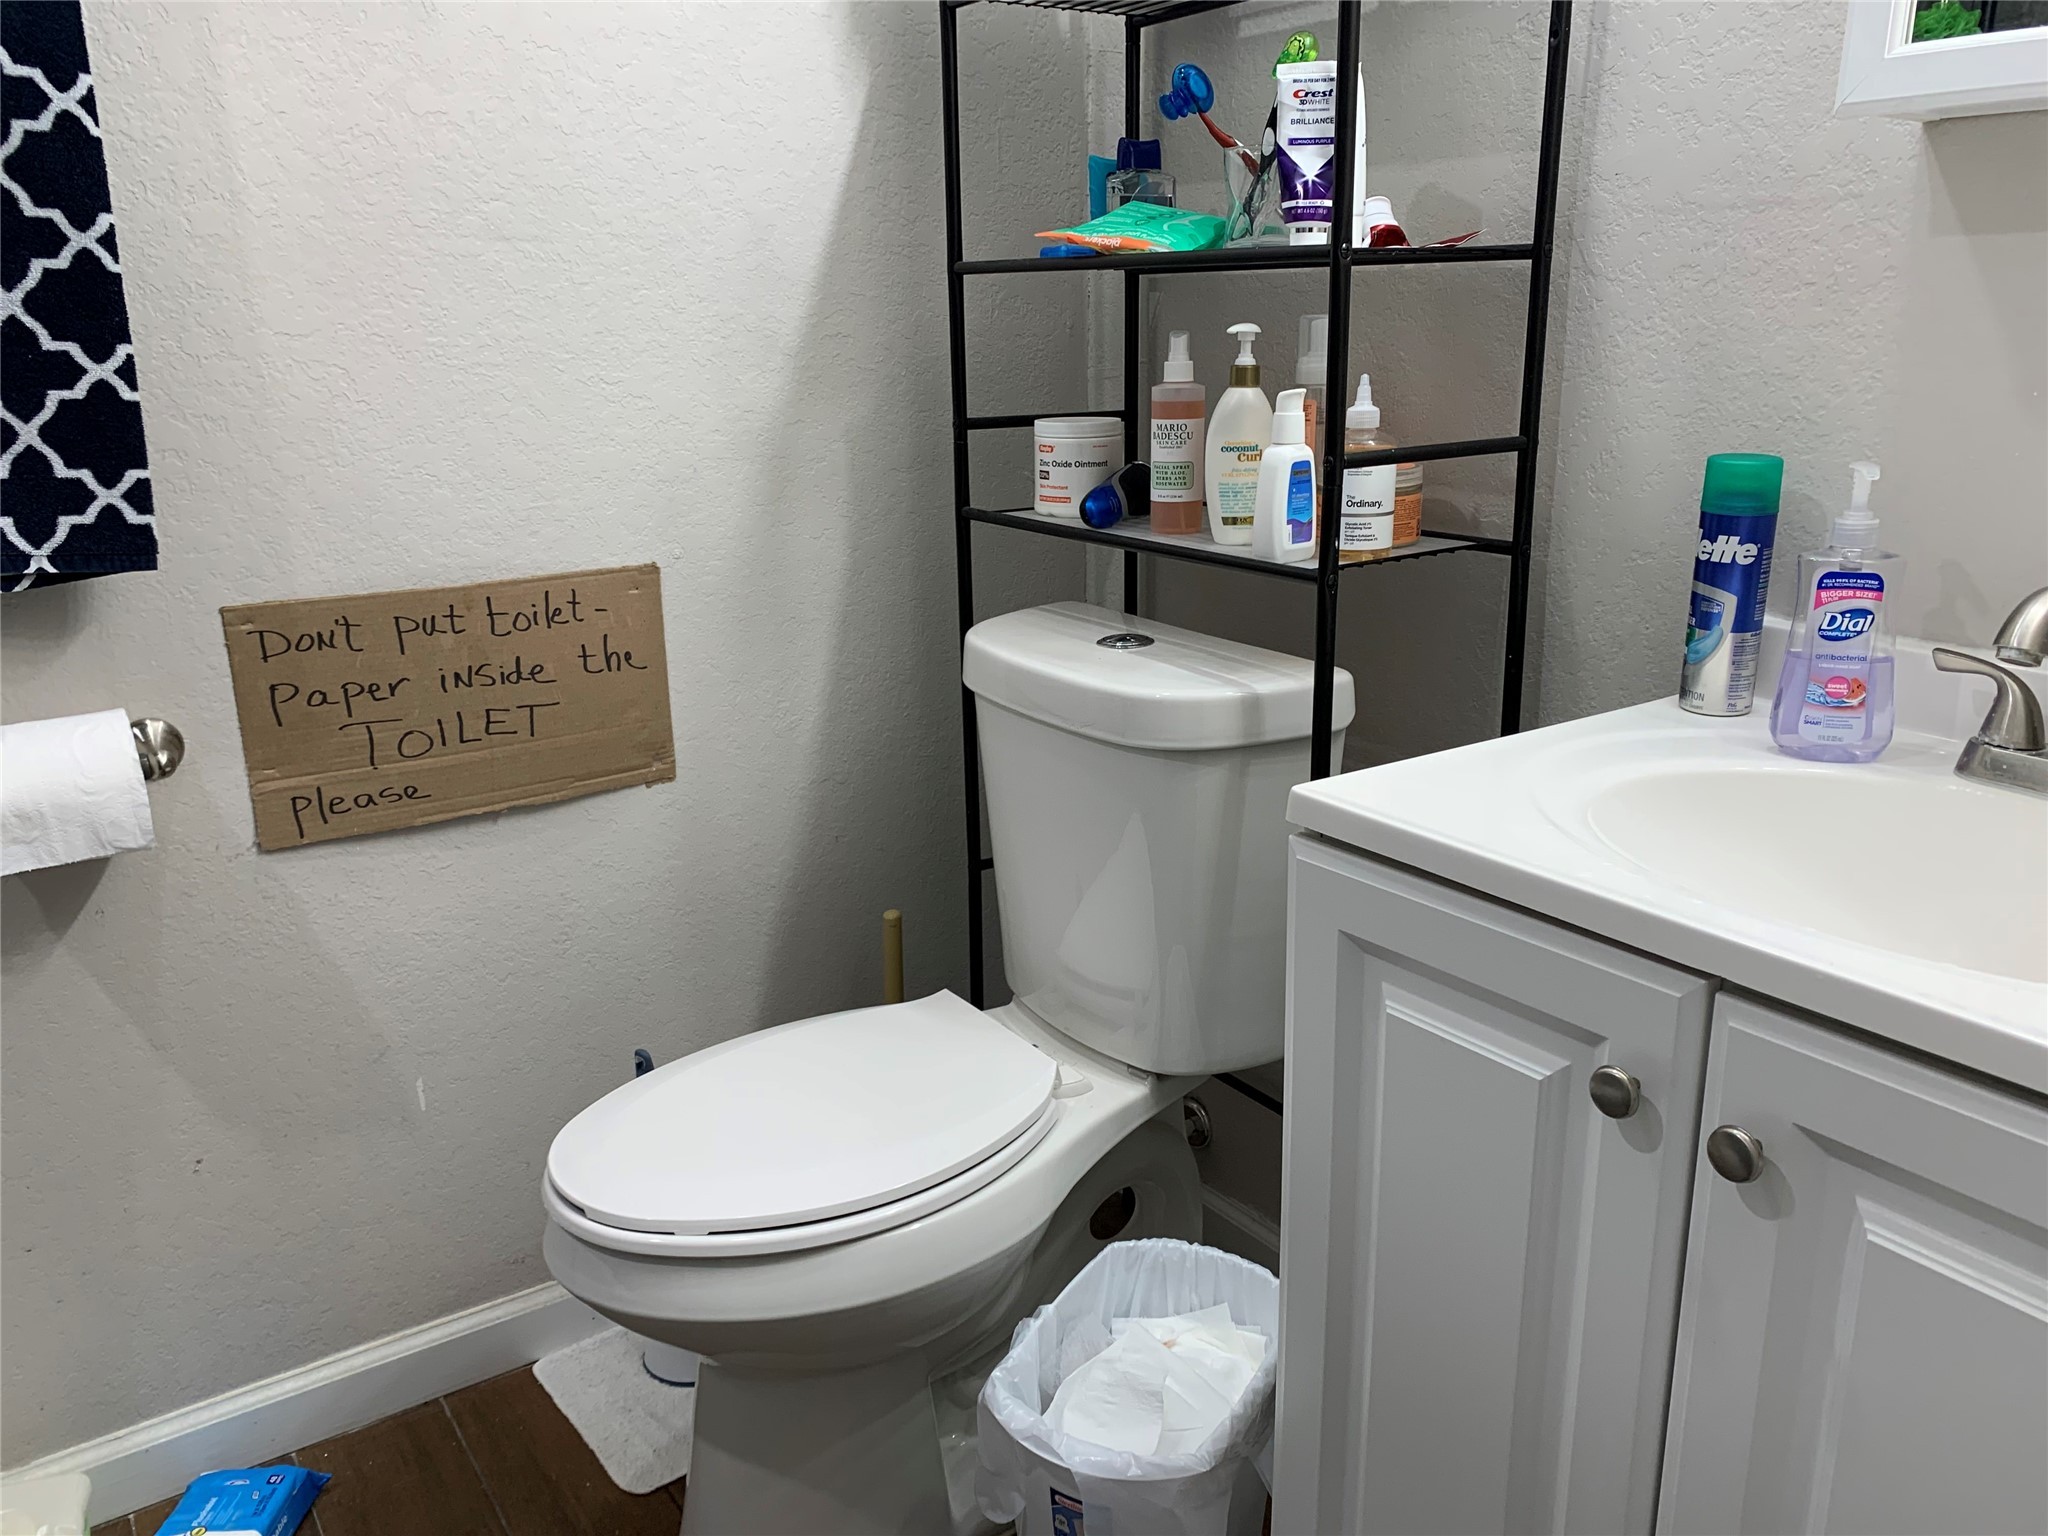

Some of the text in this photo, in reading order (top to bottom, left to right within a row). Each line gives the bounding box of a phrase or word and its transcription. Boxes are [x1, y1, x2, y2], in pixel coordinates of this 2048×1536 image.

[1293, 88, 1333, 98] Crest
[1290, 117, 1334, 125] BRILLIANCE
[1153, 432, 1194, 440] BADESCU
[1221, 444, 1259, 452] coconut
[1040, 459, 1050, 467] Zinc
[1074, 460, 1108, 468] Ointment
[1820, 612, 1874, 631] Dial
[394, 604, 466, 656] put
[577, 634, 648, 674] the
[1816, 654, 1868, 662] antibacterial
[338, 701, 561, 770] TOILET
